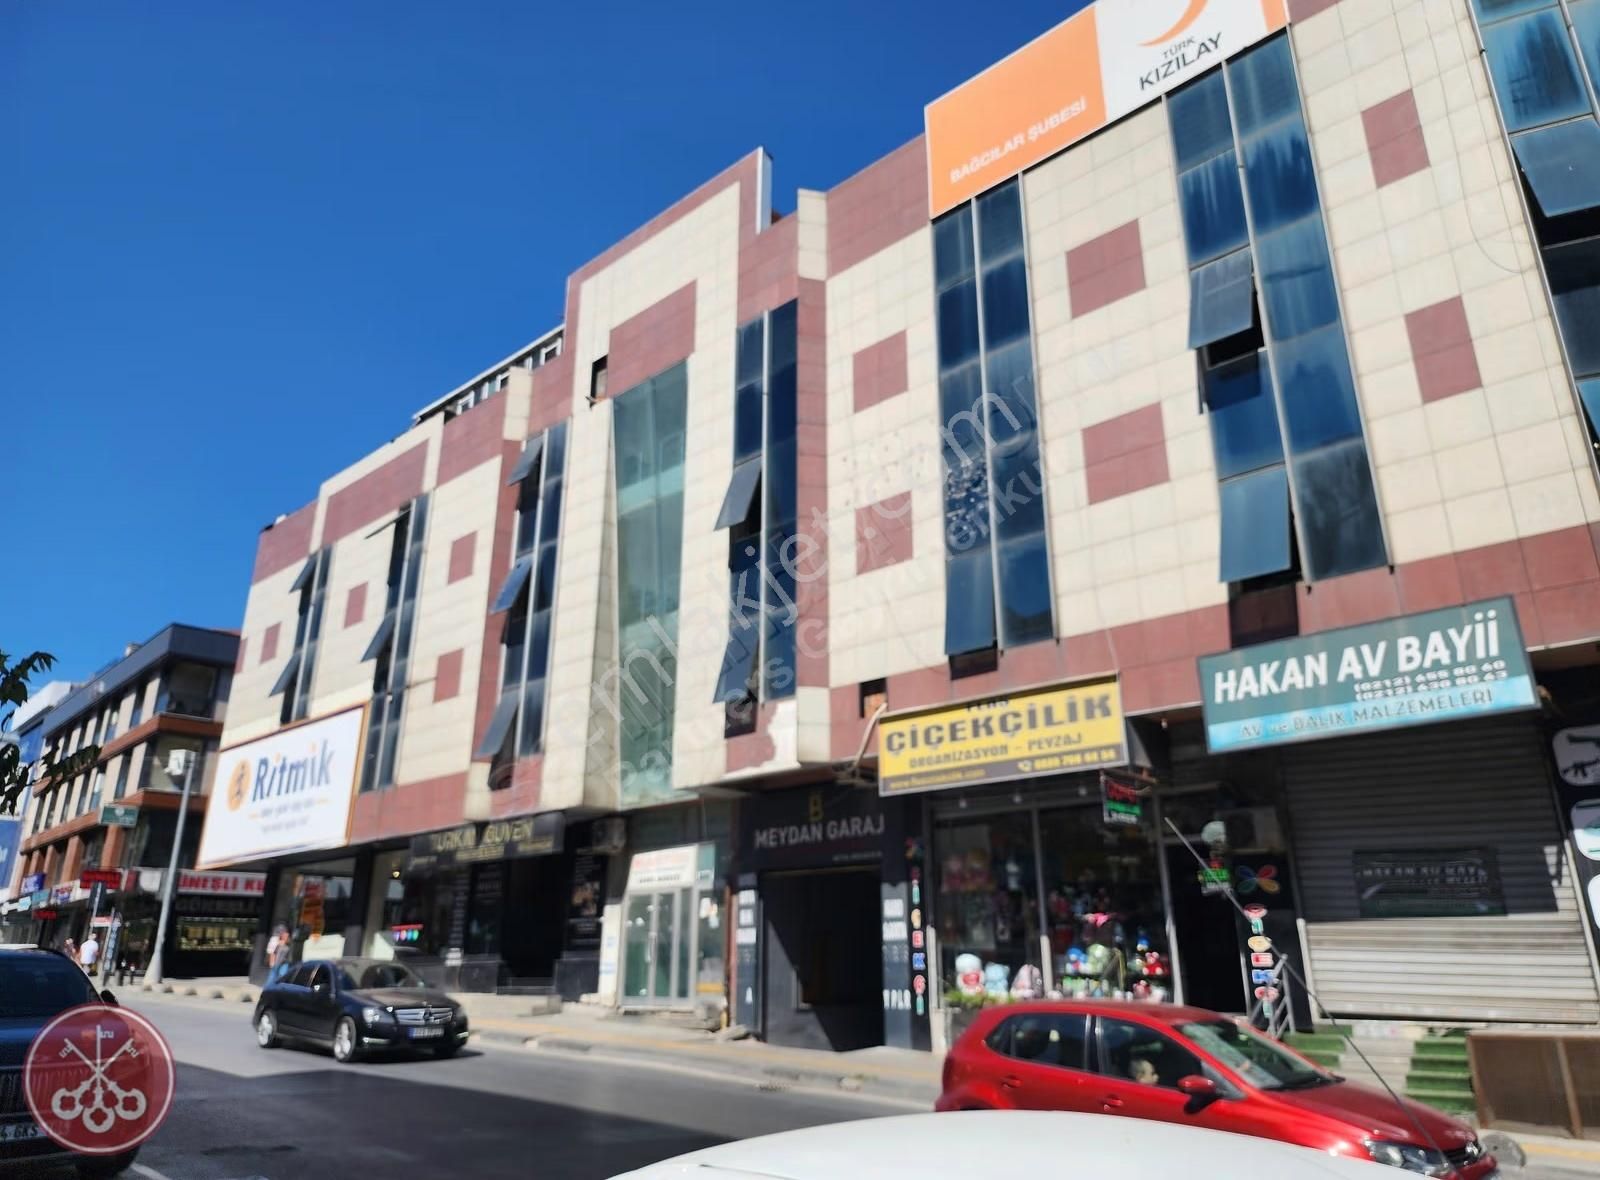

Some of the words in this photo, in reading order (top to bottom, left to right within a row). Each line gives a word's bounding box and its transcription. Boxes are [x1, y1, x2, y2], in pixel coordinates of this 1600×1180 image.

[1139, 31, 1221, 90] KIZILAY
[950, 133, 1025, 184] BAĞCILAR
[1027, 95, 1086, 142] ŞUBESİ
[1214, 651, 1328, 704] HAKAN
[1337, 641, 1387, 683] AV
[252, 738, 337, 802] Ritmik
[755, 822, 823, 849] MEYDAN
[826, 813, 885, 840] GARAJ
